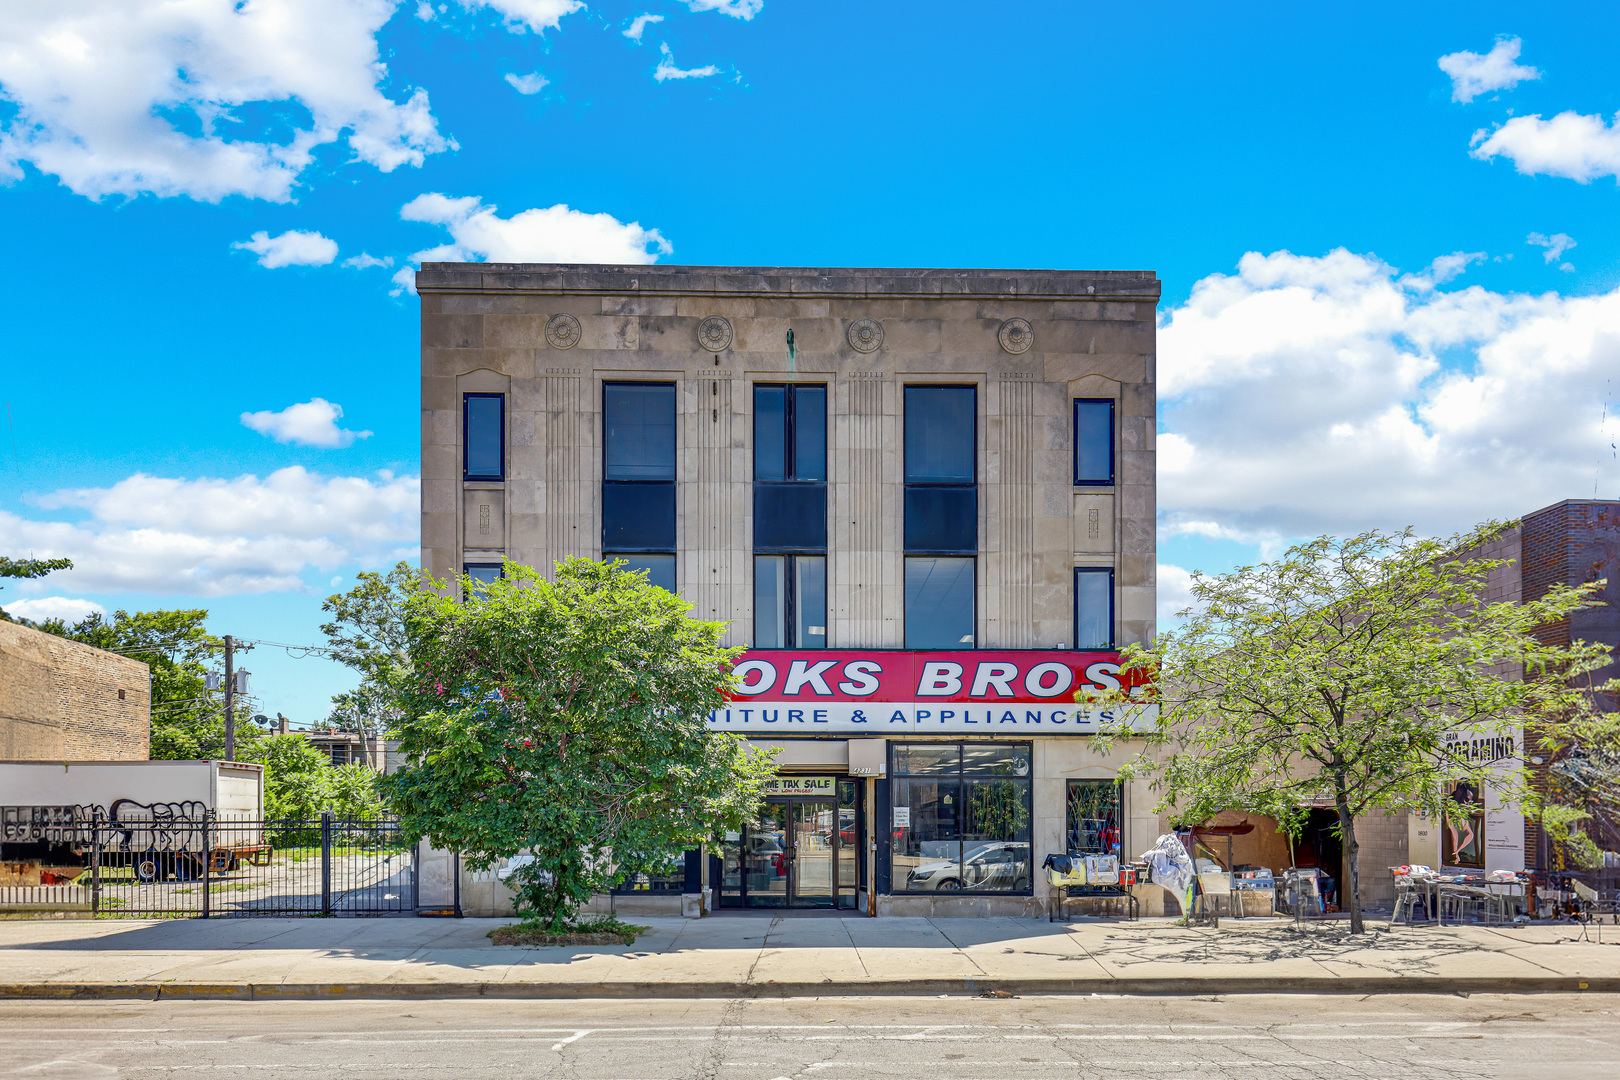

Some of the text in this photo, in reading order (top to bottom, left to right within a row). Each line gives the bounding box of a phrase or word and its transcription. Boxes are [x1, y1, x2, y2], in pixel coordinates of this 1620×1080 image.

[731, 659, 883, 697] OKS
[701, 709, 1115, 724] NITURE & APPLIANCES
[1445, 731, 1459, 741] GRAN
[782, 779, 800, 789] TAX
[804, 779, 831, 789] SALE
